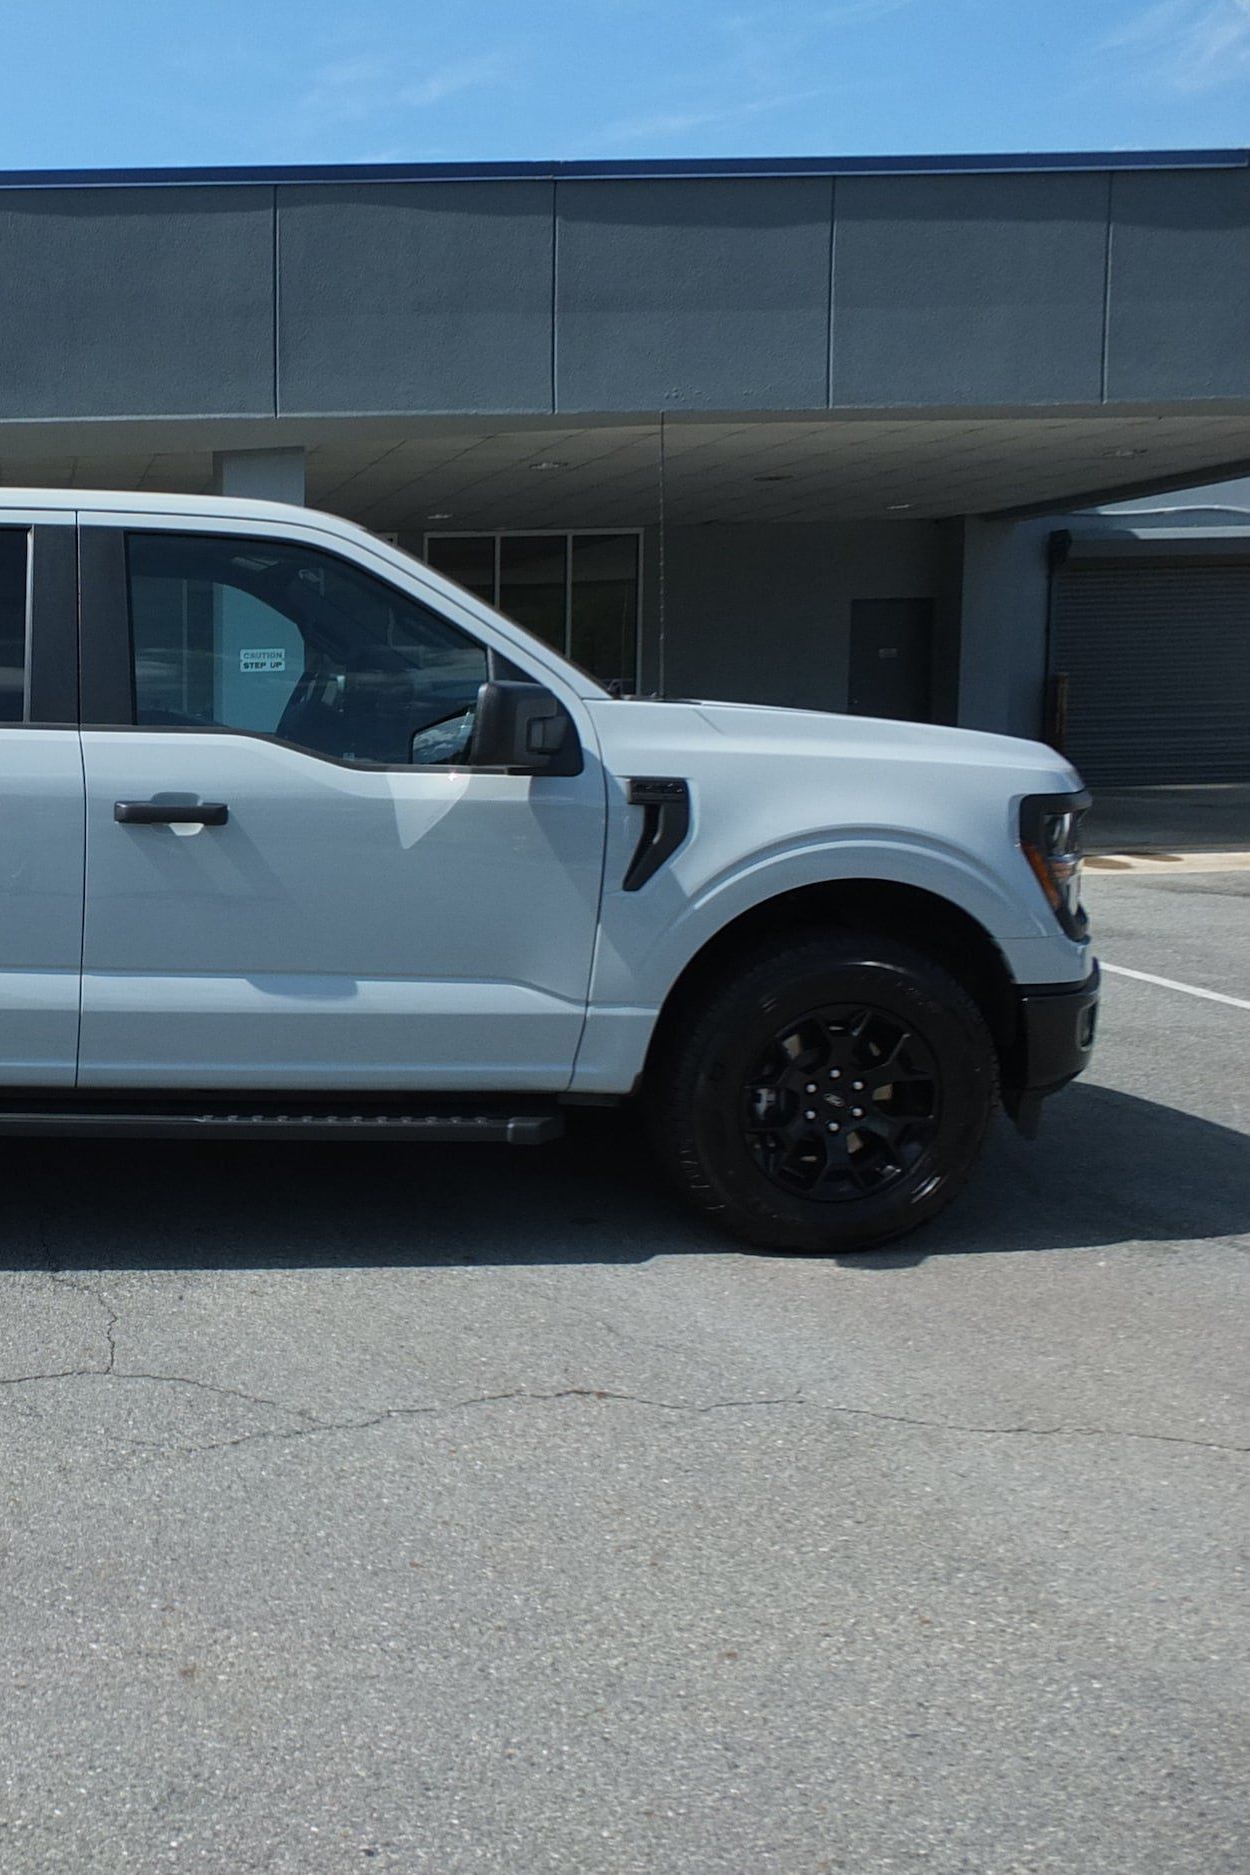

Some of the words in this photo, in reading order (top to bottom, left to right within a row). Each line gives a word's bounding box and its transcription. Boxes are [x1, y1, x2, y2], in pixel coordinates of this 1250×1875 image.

[243, 652, 283, 660] CAUTION
[243, 661, 267, 669] STEP
[270, 661, 283, 669] UP
